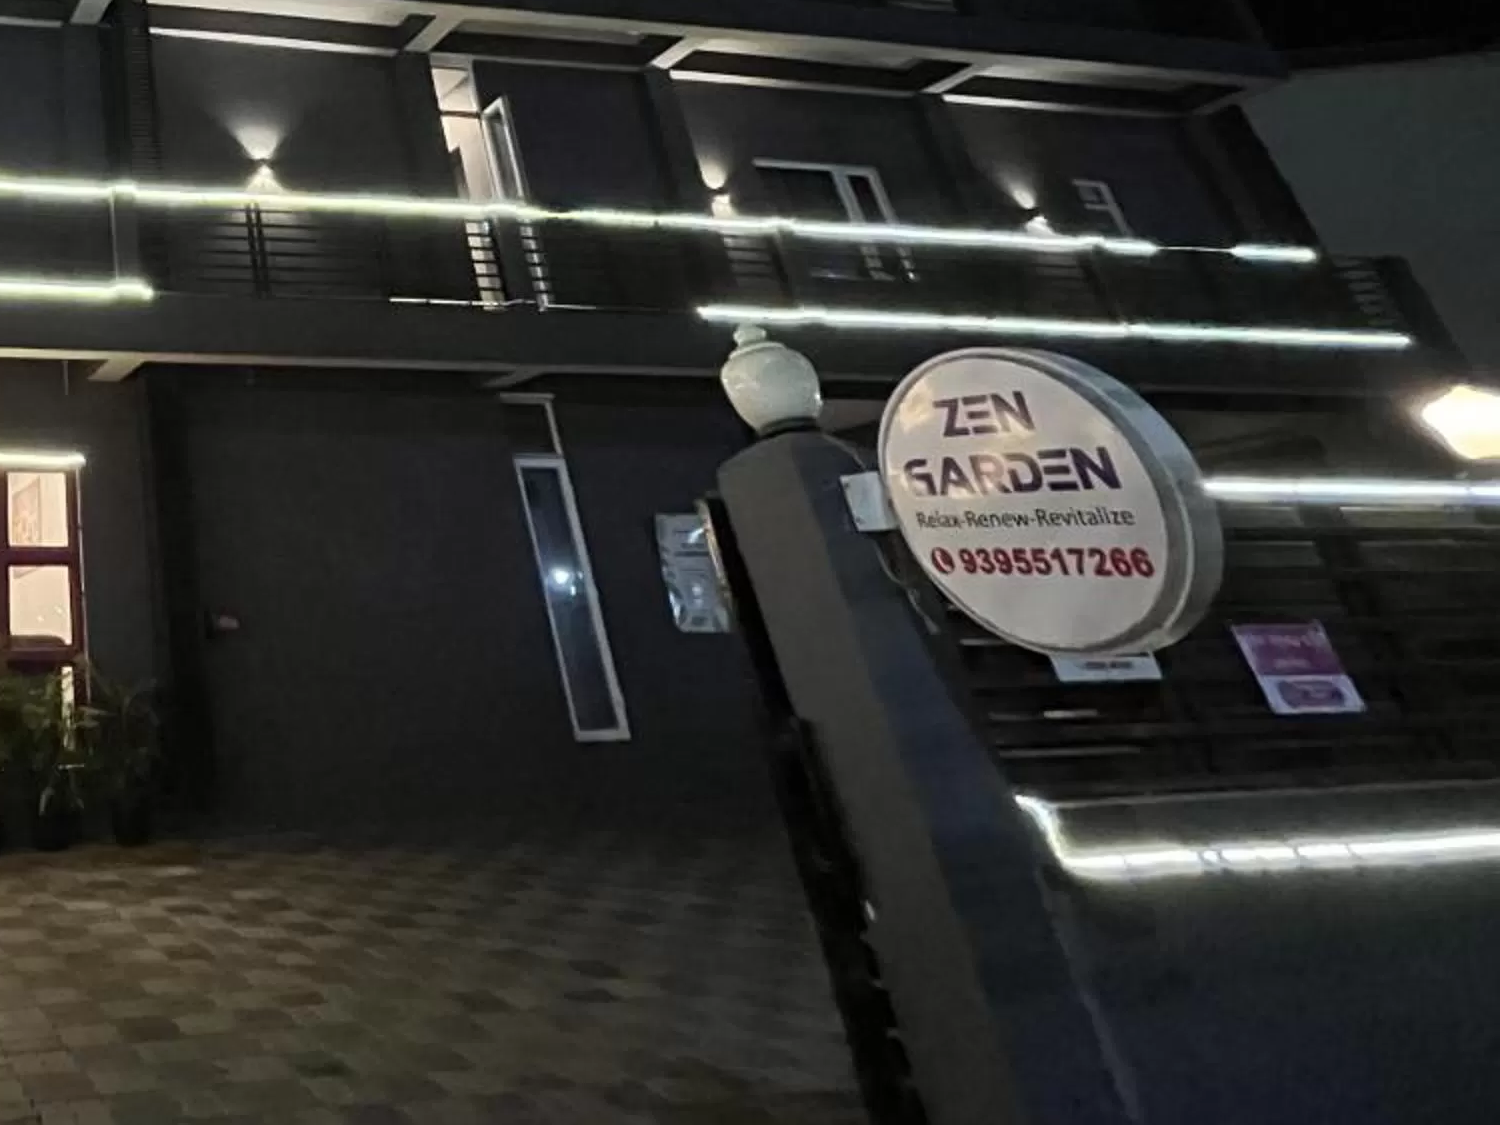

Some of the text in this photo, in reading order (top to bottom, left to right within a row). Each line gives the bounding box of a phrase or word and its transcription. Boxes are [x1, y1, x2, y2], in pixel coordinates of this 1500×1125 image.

[932, 390, 1036, 438] ZEN
[904, 446, 1122, 497] GARDEN
[958, 547, 1156, 578] 9395517266
